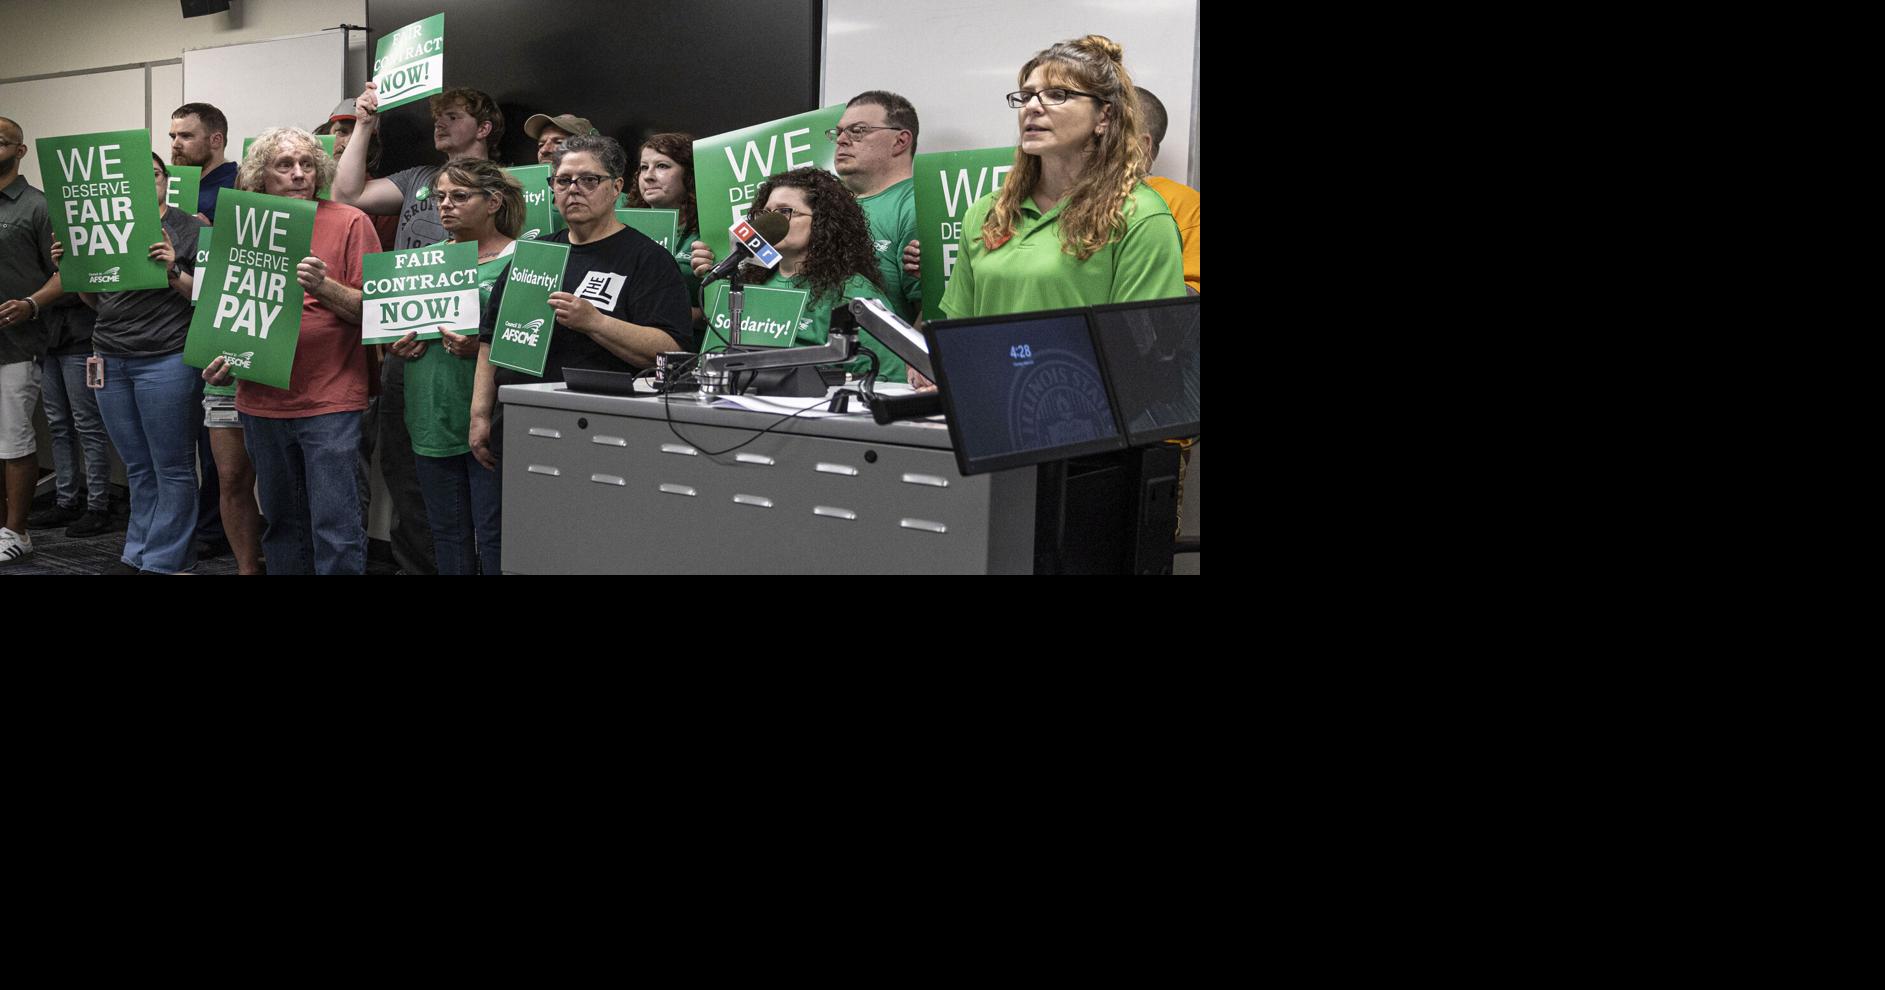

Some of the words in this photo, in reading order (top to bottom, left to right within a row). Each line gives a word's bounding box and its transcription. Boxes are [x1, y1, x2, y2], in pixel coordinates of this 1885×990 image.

[374, 37, 442, 72] CORACT
[380, 61, 429, 94] NOW!
[57, 144, 123, 182] WE
[725, 128, 813, 182] WE
[62, 181, 130, 198] DESERVE
[64, 197, 134, 224] FAIR
[68, 222, 135, 257] PAY
[236, 205, 290, 253] WE
[738, 226, 773, 257] npr
[229, 247, 289, 272] DESERVE
[394, 250, 445, 269] FAIR
[89, 275, 120, 283] AFSCME
[223, 264, 287, 303] FAIR
[363, 268, 478, 294] CONTRACT
[511, 267, 559, 292] Solidarity!
[582, 276, 605, 295] THE
[213, 294, 283, 340] PAY
[380, 296, 460, 324] NOW!
[501, 328, 539, 347] AFSCME
[714, 314, 791, 339] Sodarity!
[1010, 344, 1032, 359] 4:28
